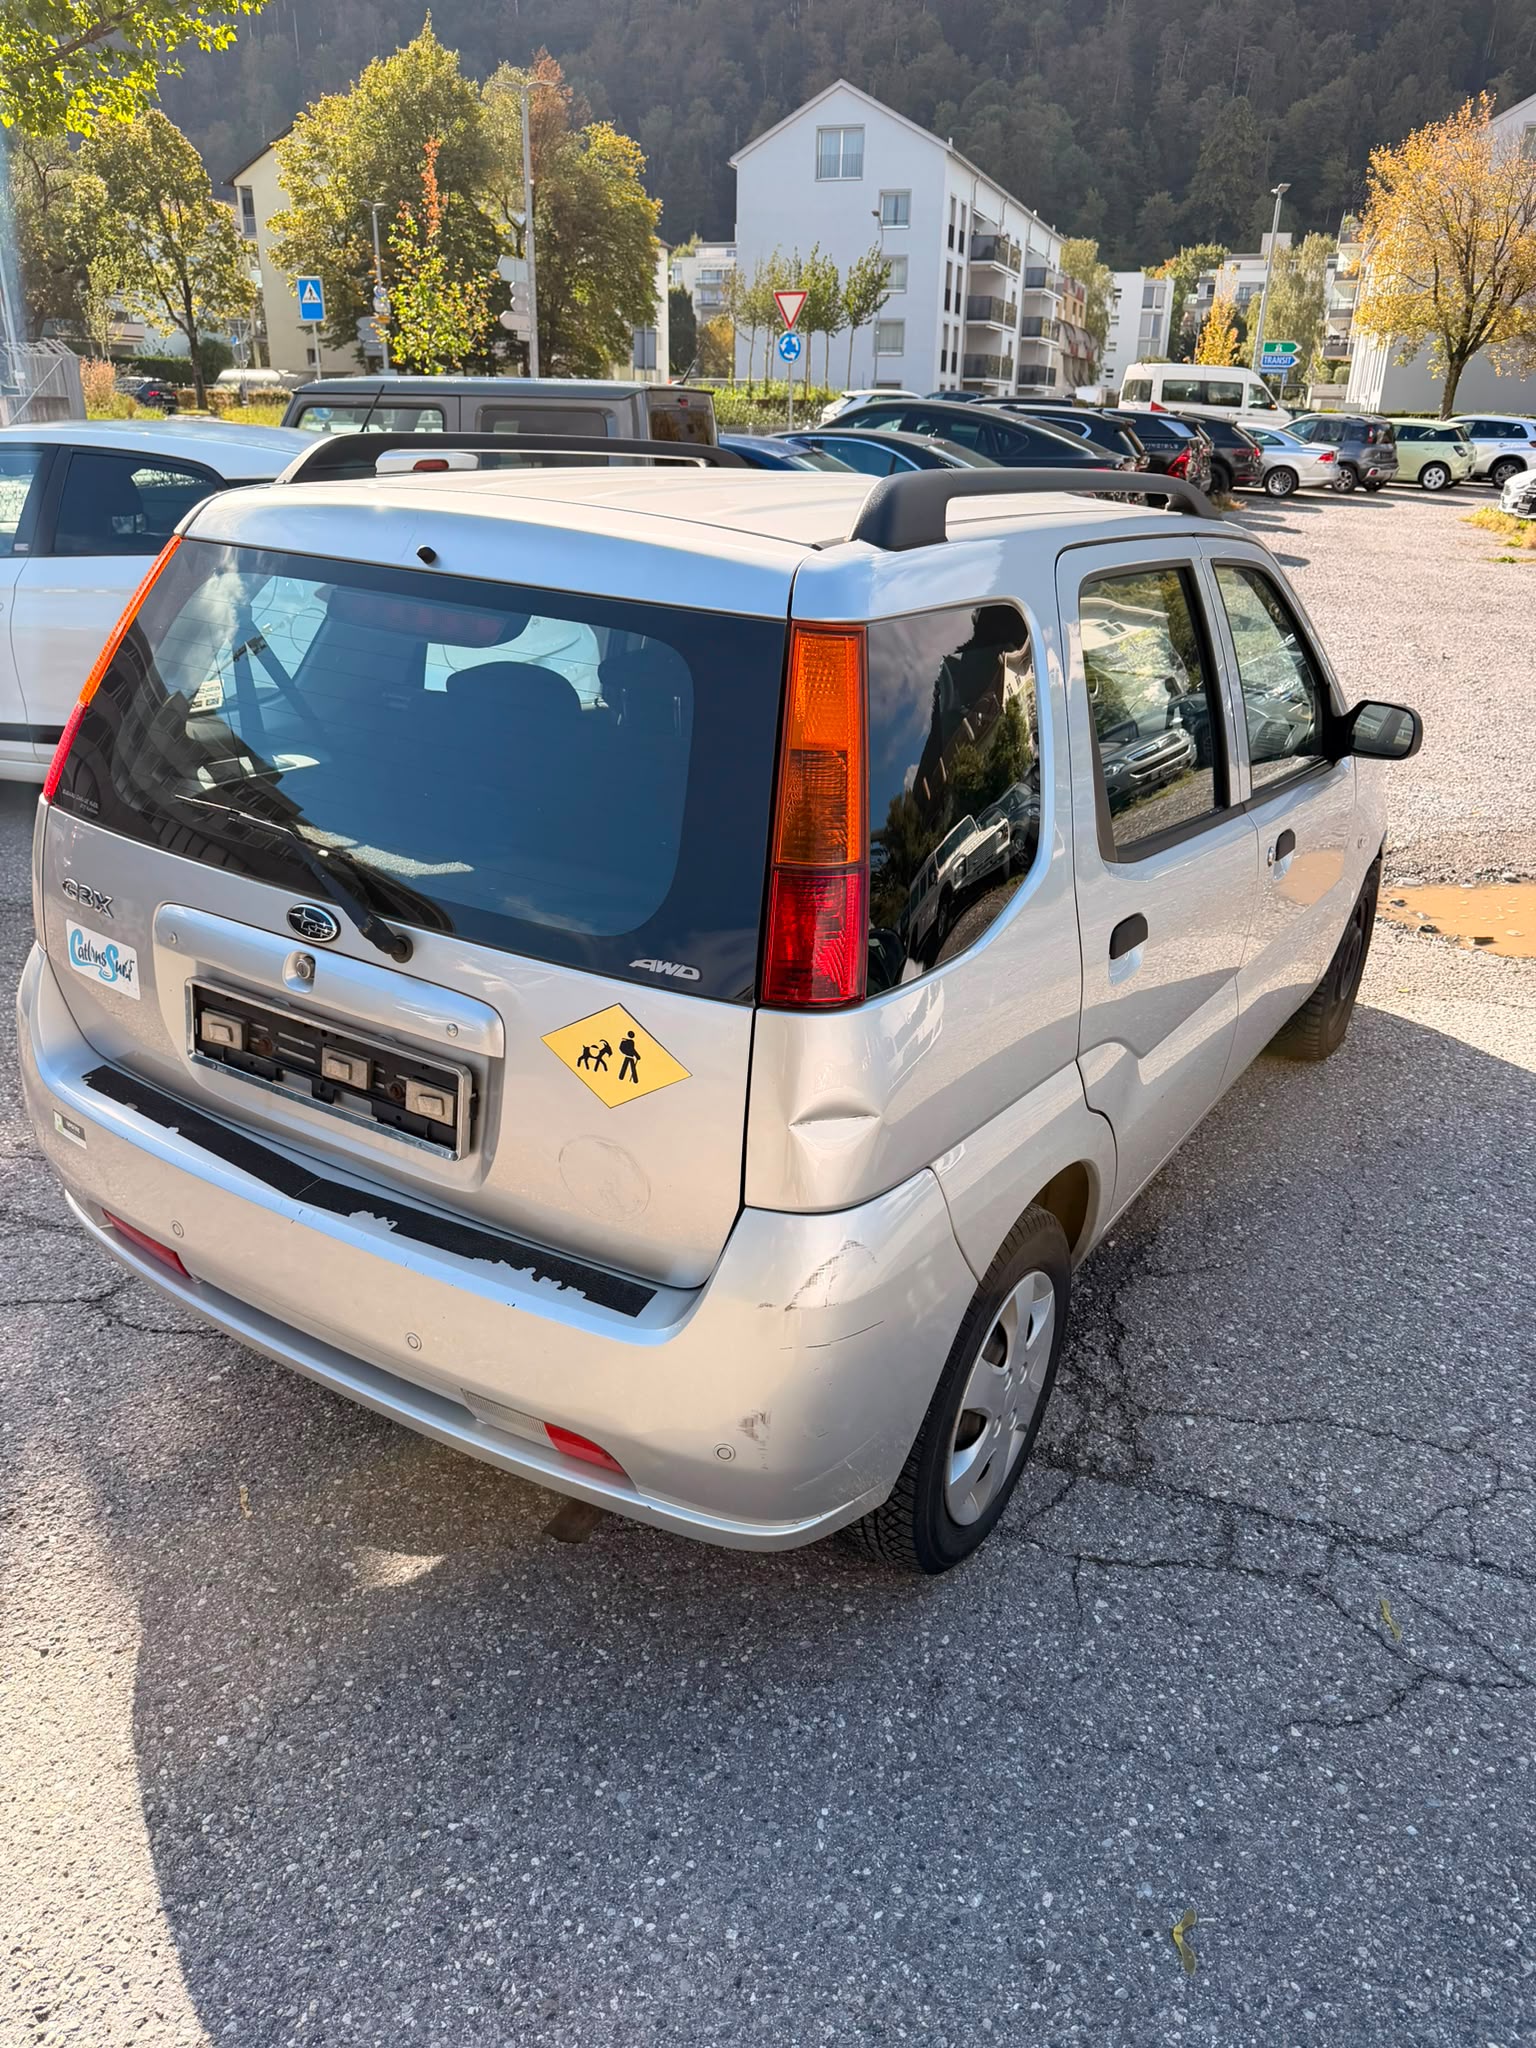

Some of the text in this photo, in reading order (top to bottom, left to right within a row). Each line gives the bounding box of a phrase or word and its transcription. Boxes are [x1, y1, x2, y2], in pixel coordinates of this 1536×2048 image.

[1264, 356, 1292, 365] TRANSIT
[62, 878, 114, 919] G3X
[629, 958, 701, 981] AWD
